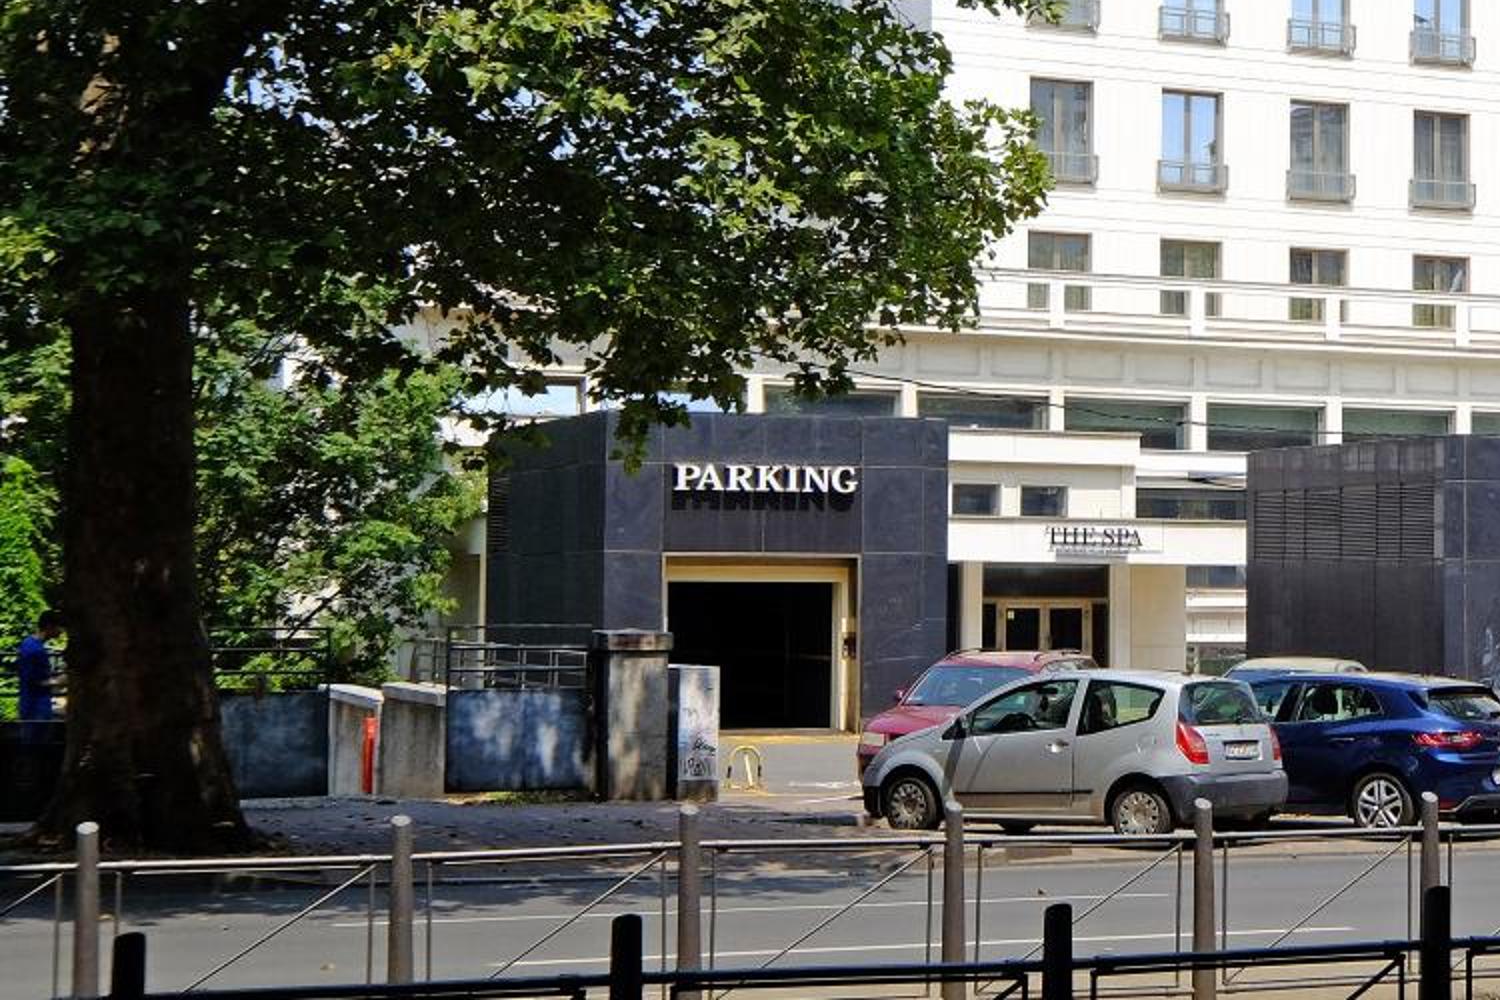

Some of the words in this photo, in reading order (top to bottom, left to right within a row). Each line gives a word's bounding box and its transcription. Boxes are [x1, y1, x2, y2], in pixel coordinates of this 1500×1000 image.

[673, 462, 859, 493] PARKING
[1046, 526, 1098, 546] THE
[1101, 527, 1143, 546] SPA
